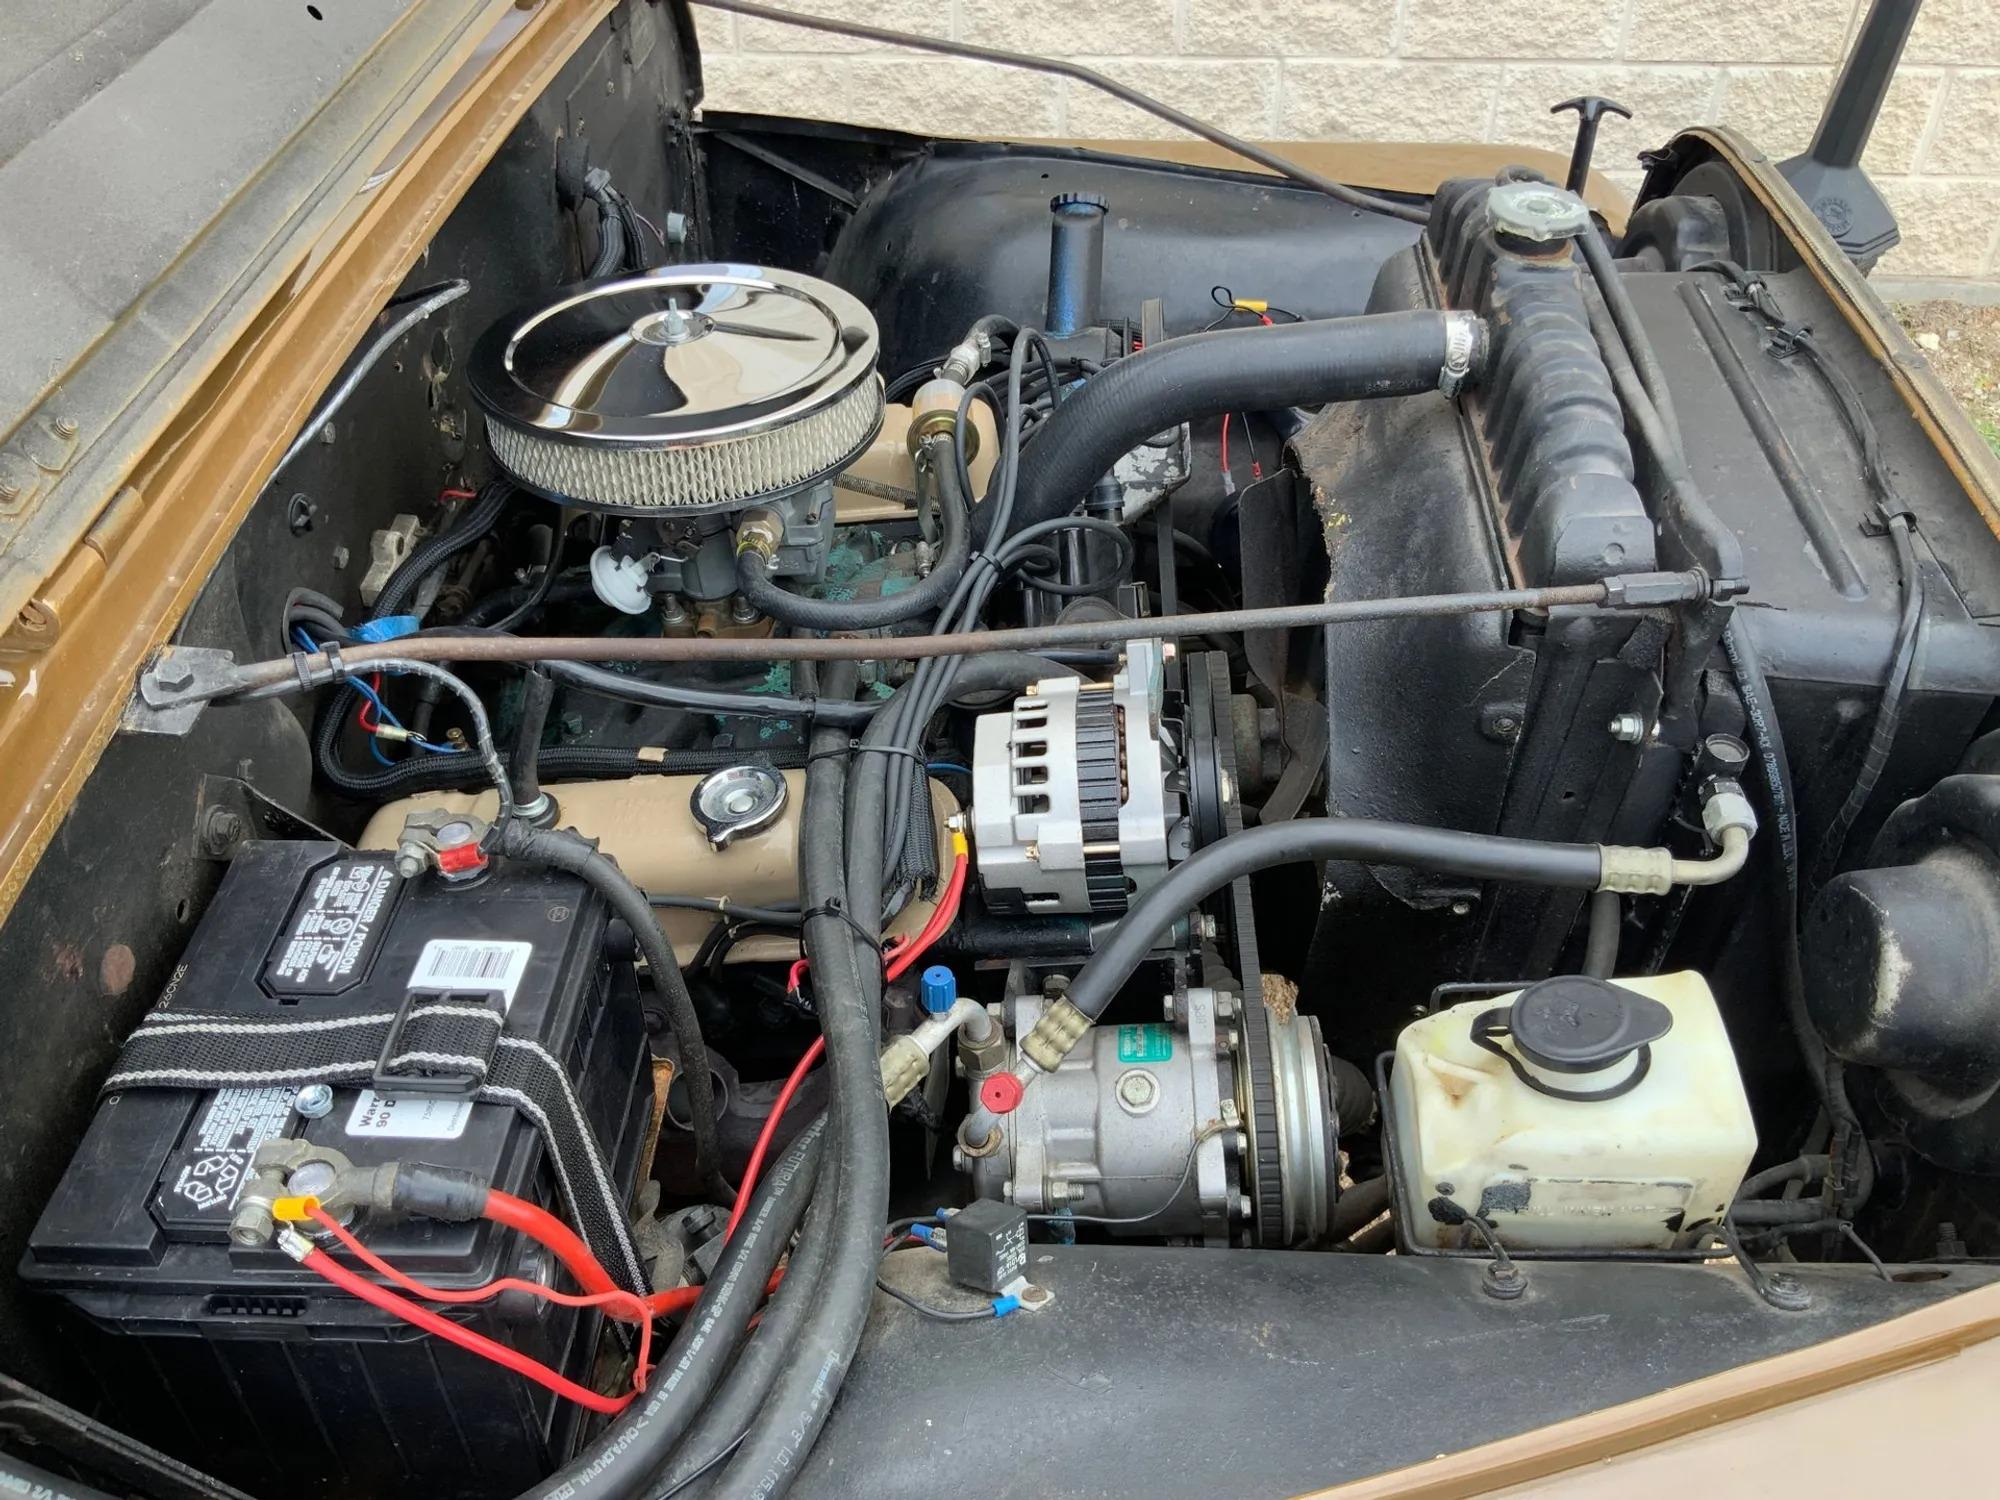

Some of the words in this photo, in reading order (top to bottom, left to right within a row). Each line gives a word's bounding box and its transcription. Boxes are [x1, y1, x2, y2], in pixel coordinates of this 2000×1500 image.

[359, 878, 392, 922] DANGER
[336, 931, 368, 973] POISON
[374, 1111, 391, 1128] 90
